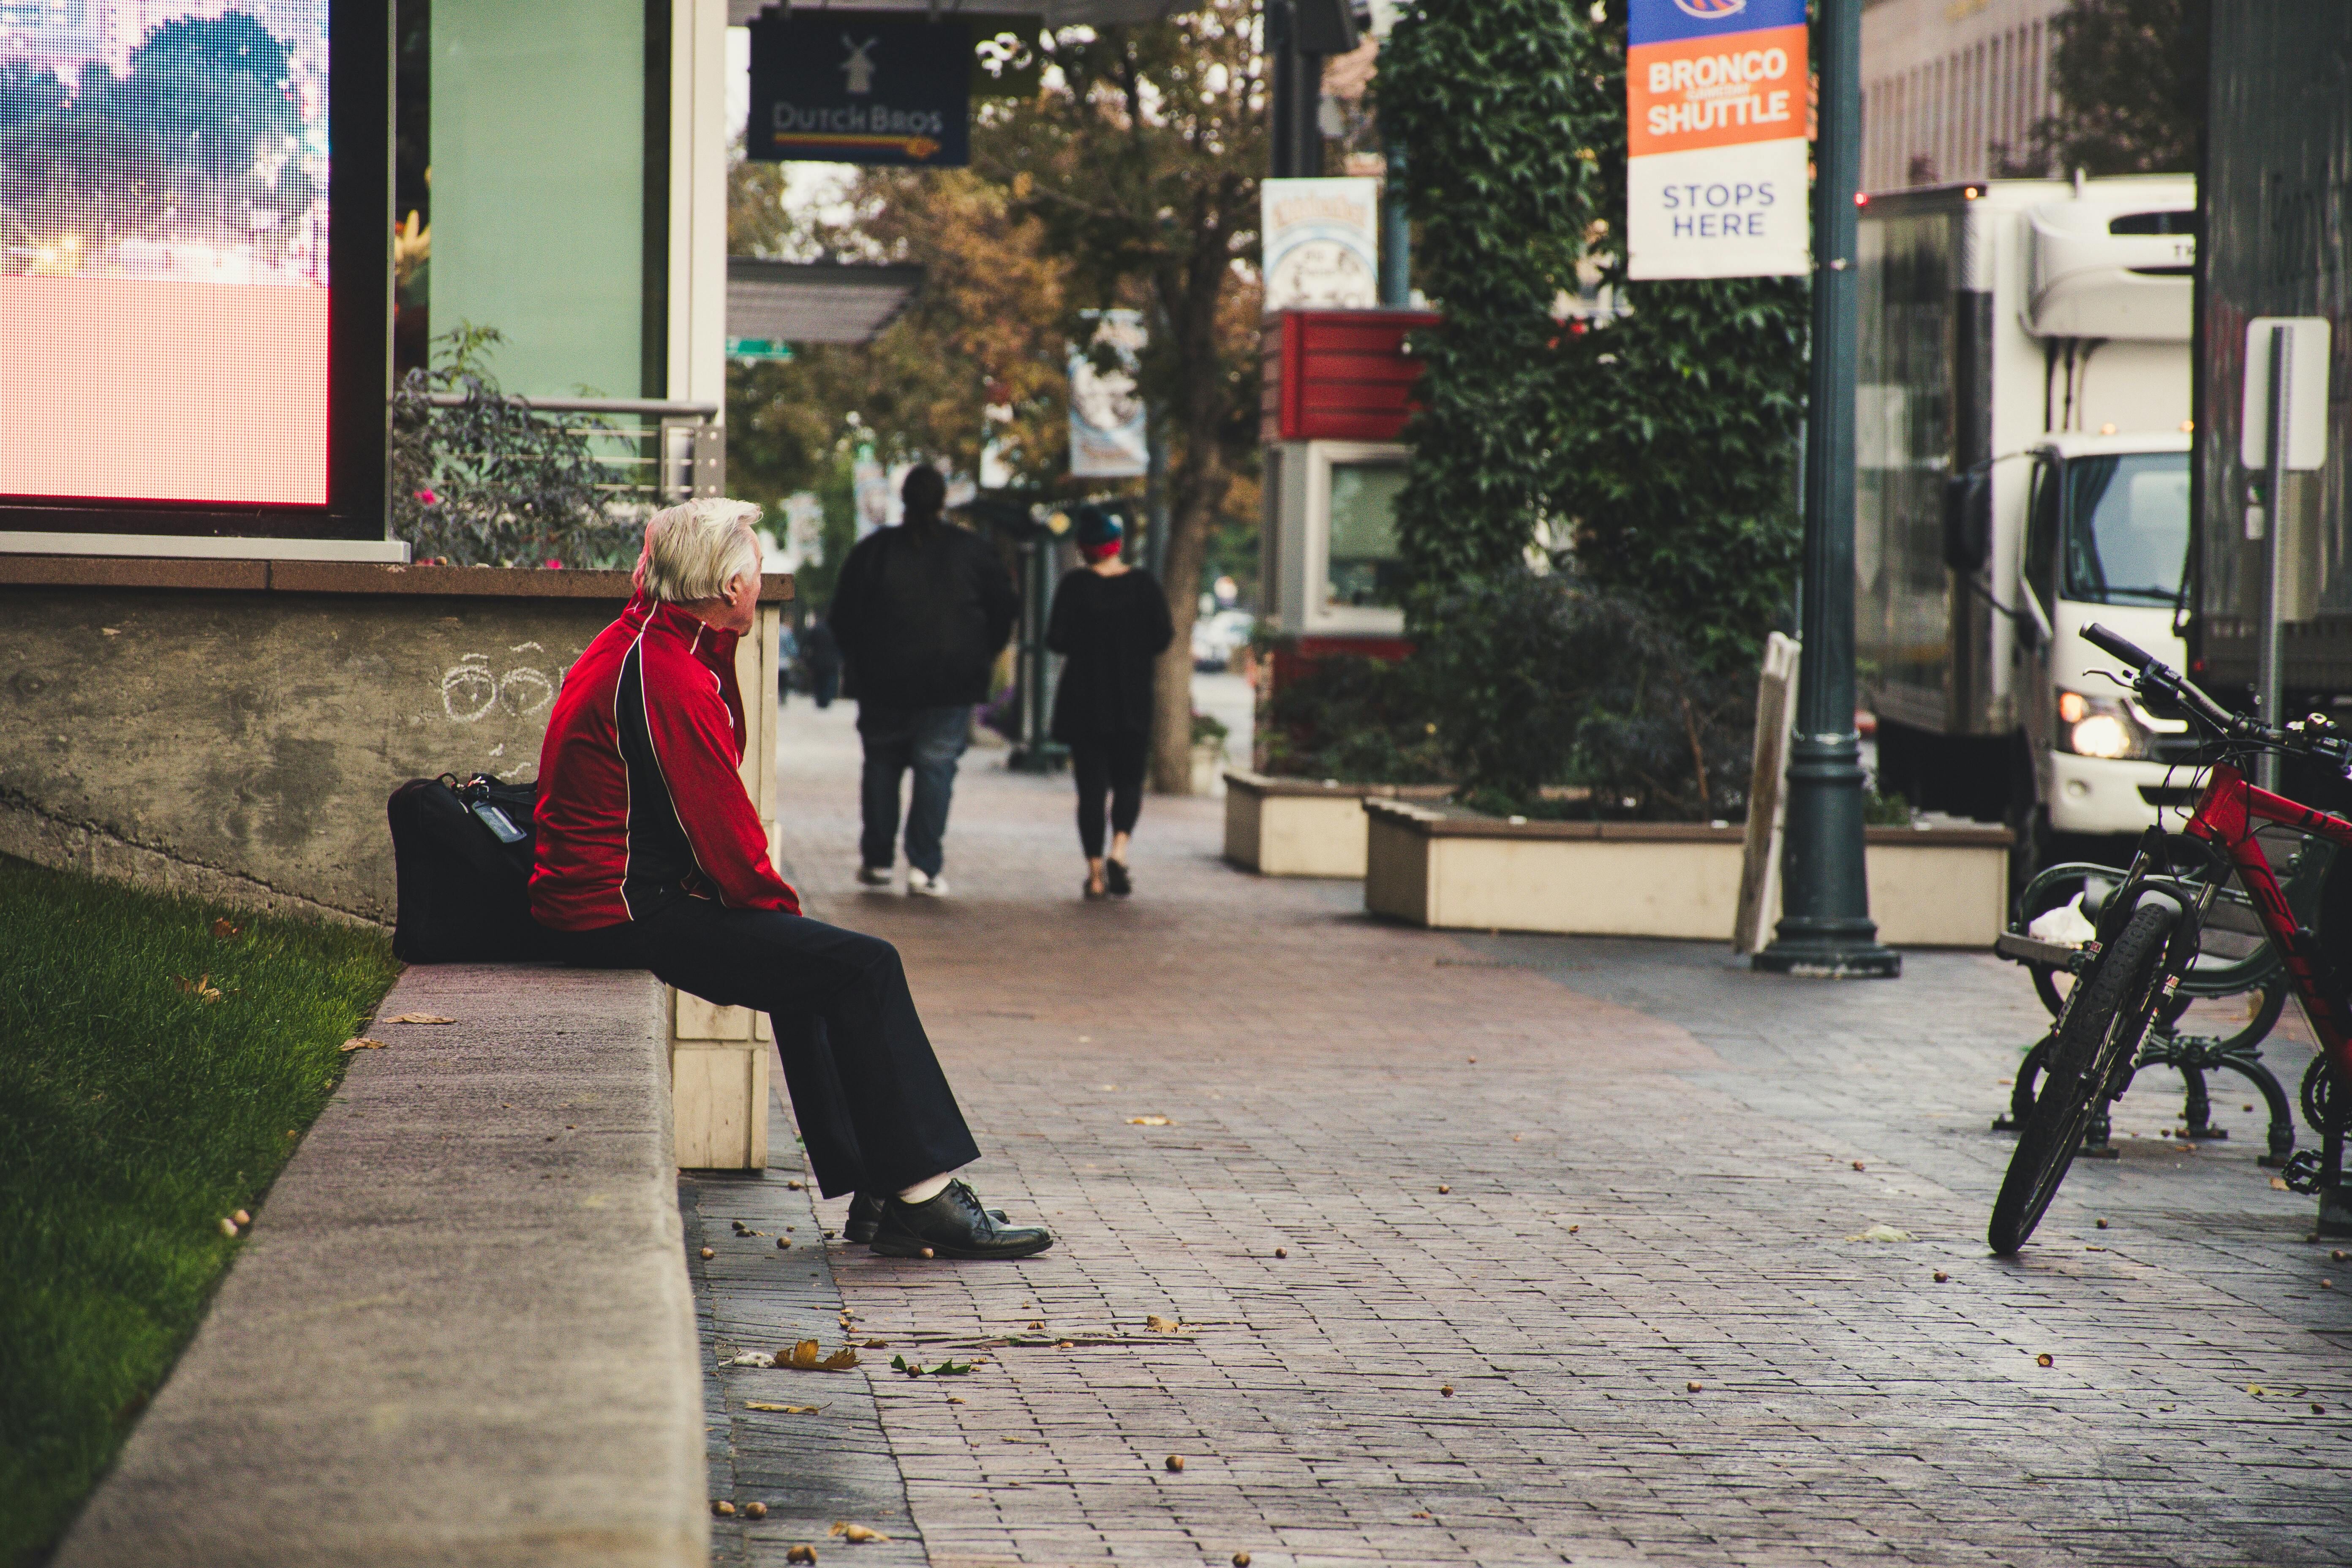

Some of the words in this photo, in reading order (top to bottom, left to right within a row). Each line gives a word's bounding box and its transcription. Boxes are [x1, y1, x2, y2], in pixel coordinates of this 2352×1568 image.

[1649, 47, 1788, 93] BRONCO
[1648, 89, 1791, 136] SHUTTLE
[1663, 183, 1775, 209] STOPS
[1673, 212, 1765, 237] HERE
